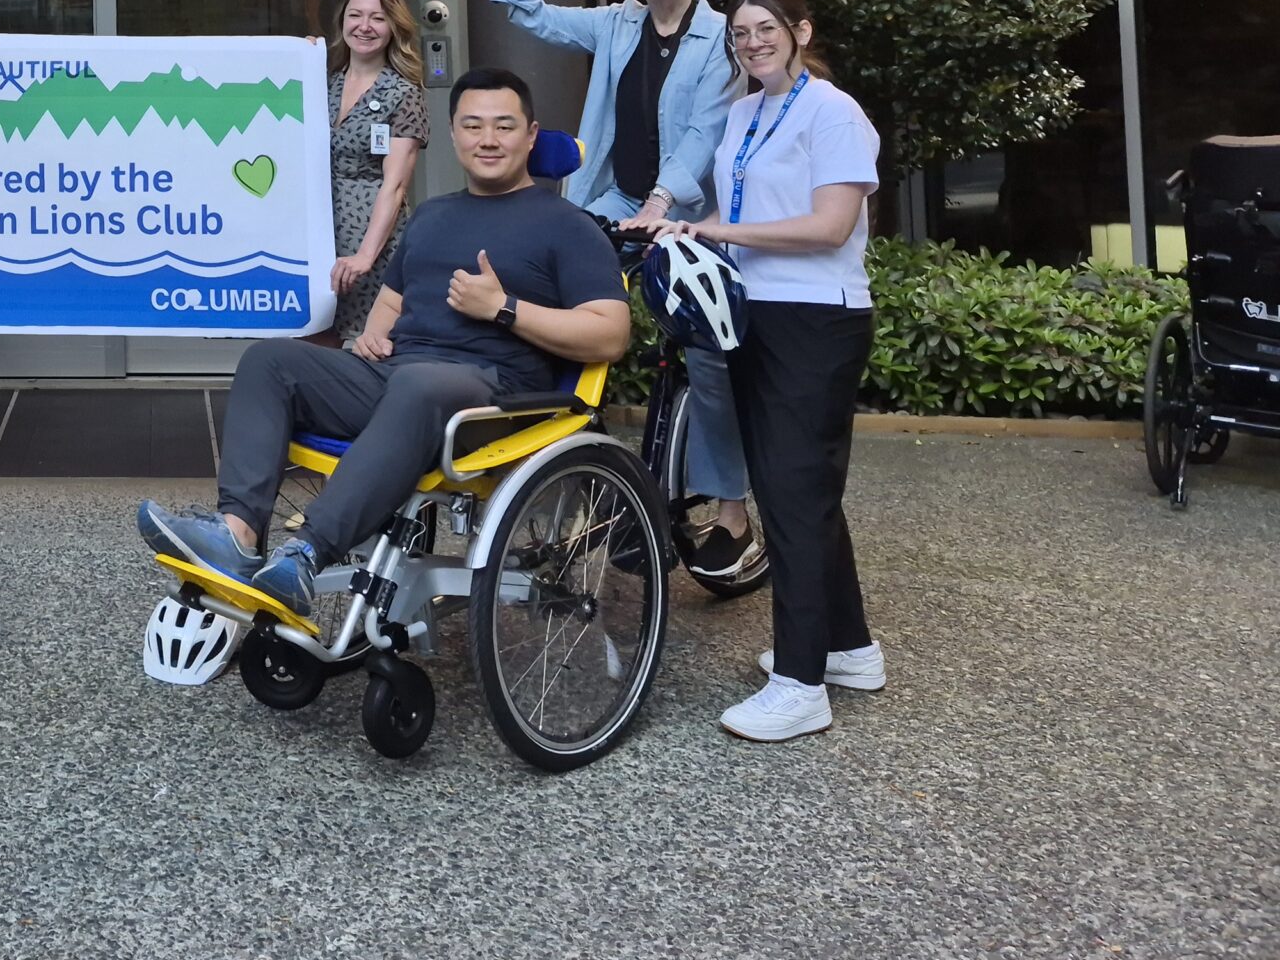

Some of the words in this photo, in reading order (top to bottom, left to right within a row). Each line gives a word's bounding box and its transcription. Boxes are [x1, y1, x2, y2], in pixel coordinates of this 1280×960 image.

[58, 162, 101, 201] by
[111, 162, 173, 193] the
[30, 204, 125, 235] Lions
[137, 204, 224, 235] Club
